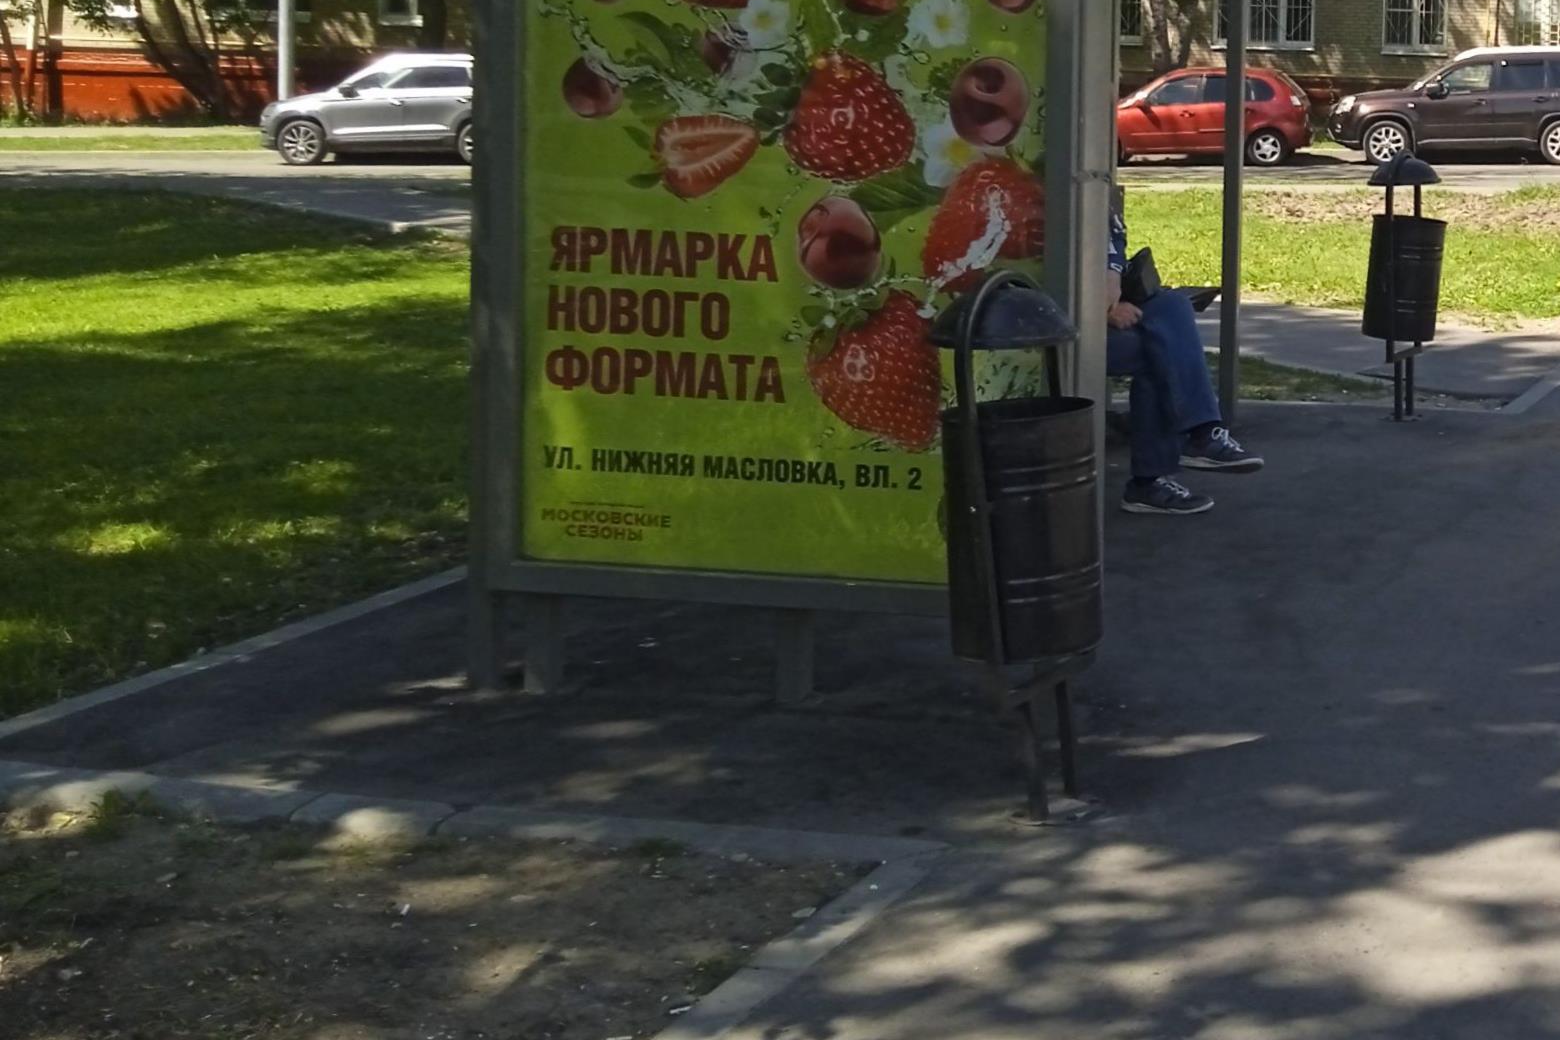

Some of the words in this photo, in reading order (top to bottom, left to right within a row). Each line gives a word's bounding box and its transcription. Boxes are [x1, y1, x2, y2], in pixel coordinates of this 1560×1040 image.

[549, 225, 779, 282] ЯРМАРКА
[547, 284, 730, 340] НОВОГО
[545, 345, 786, 403] ФОРМАТА
[543, 444, 581, 471] УЛ.
[591, 448, 696, 477] НИЖНЯЯ
[703, 455, 846, 490] МАСЛОВКА,
[855, 464, 898, 489] ВЛ.
[907, 467, 923, 491] 2
[541, 508, 673, 528] МОСКОВСКИЕ
[565, 524, 644, 541] СЕЗОНЫ
